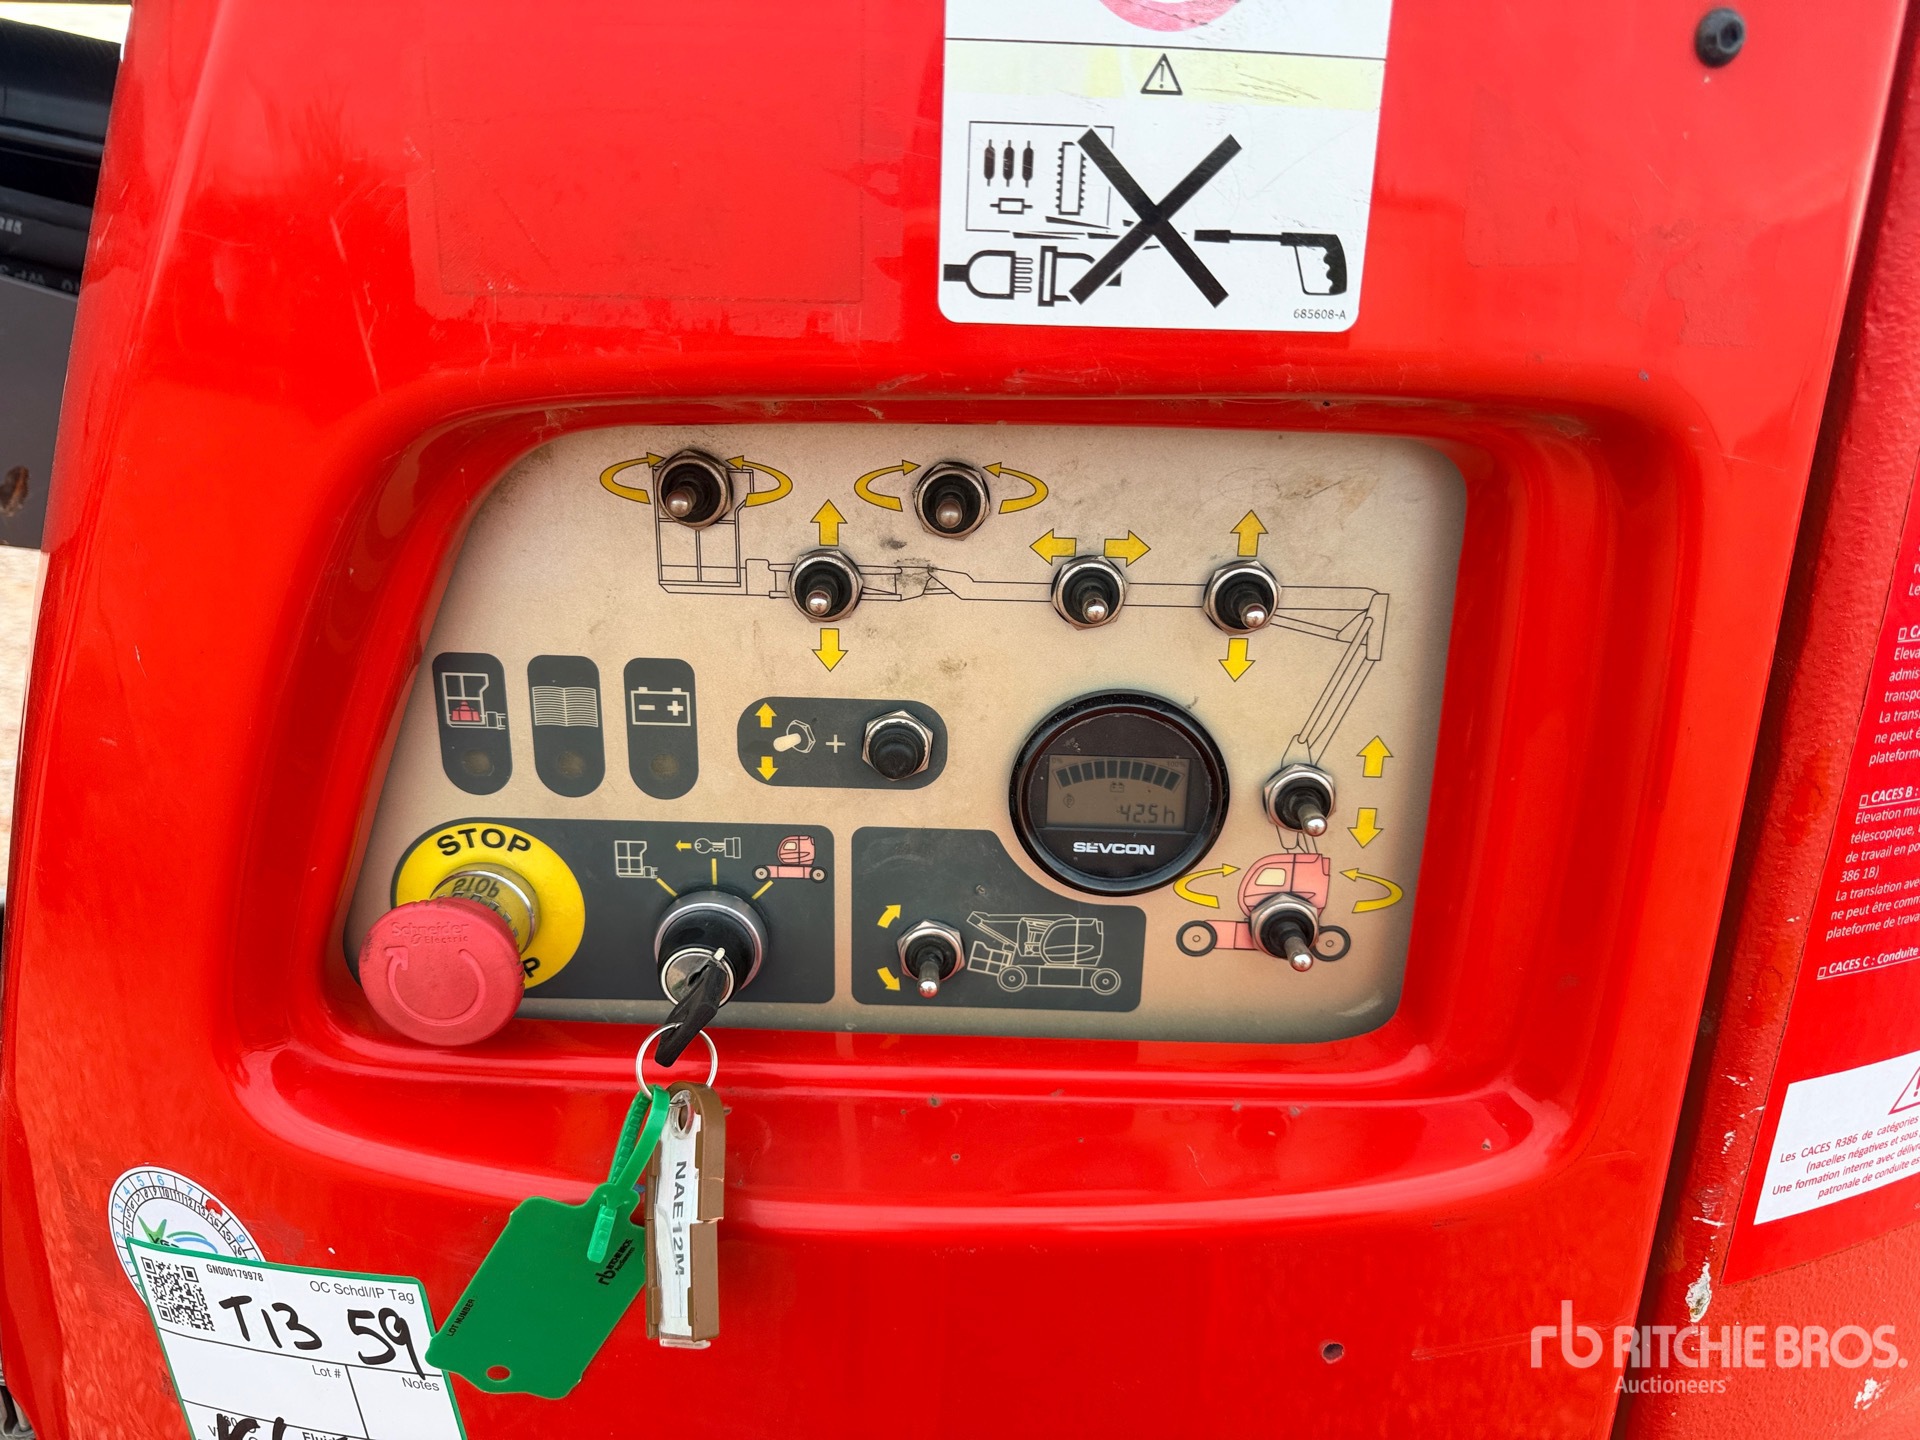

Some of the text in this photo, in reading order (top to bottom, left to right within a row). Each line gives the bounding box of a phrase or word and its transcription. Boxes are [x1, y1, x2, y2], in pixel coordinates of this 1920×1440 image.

[1293, 308, 1346, 320] 685608-A
[1879, 711, 1891, 723] La
[1874, 733, 1887, 744] ne
[1889, 729, 1914, 745] peut
[1871, 786, 1905, 803] CACES
[1905, 785, 1913, 798] B
[1855, 808, 1902, 825] Elevation
[437, 827, 532, 856] STOP
[1850, 825, 1915, 845] télescopique,
[1072, 841, 1155, 856] SEVCON
[1845, 851, 1858, 863] de
[1860, 845, 1893, 861] travail
[1893, 844, 1906, 856] en
[1840, 865, 1880, 883] 386 1B)
[1835, 890, 1847, 902] La
[1849, 880, 1902, 899] translation
[1830, 910, 1844, 920] ne
[1846, 905, 1869, 920] peut
[1871, 900, 1892, 914] être
[390, 920, 470, 937] Schneider
[1825, 920, 1881, 942] plateforme
[1883, 916, 1896, 929] de
[424, 934, 469, 945] Electric
[1828, 960, 1861, 975] CACES
[1862, 956, 1871, 967] C
[1877, 945, 1919, 965] Conduite
[1780, 1115, 1920, 1164] Les CACES R386 de catégories
[1806, 1129, 1919, 1175] (nacelles négatives et sous
[1772, 1183, 1793, 1196] Une
[1794, 1169, 1841, 1191] formation
[1842, 1158, 1875, 1177] interne
[1876, 1151, 1896, 1166] avec
[1817, 1175, 1861, 1201] patronale
[1861, 1172, 1874, 1184] de
[1874, 1160, 1910, 1180] conduite
[114, 1202, 124, 1213] 3
[122, 1185, 131, 1196] 4
[136, 1176, 145, 1187] 5
[156, 1175, 165, 1186] 6
[186, 1185, 194, 1196] 7
[206, 1263, 264, 1282] GN000179978
[310, 1280, 332, 1294] OC
[387, 1287, 415, 1304] Tag
[219, 1295, 426, 1381] T13 59
[312, 1364, 331, 1377] Lot
[402, 1377, 440, 1392] Notes
